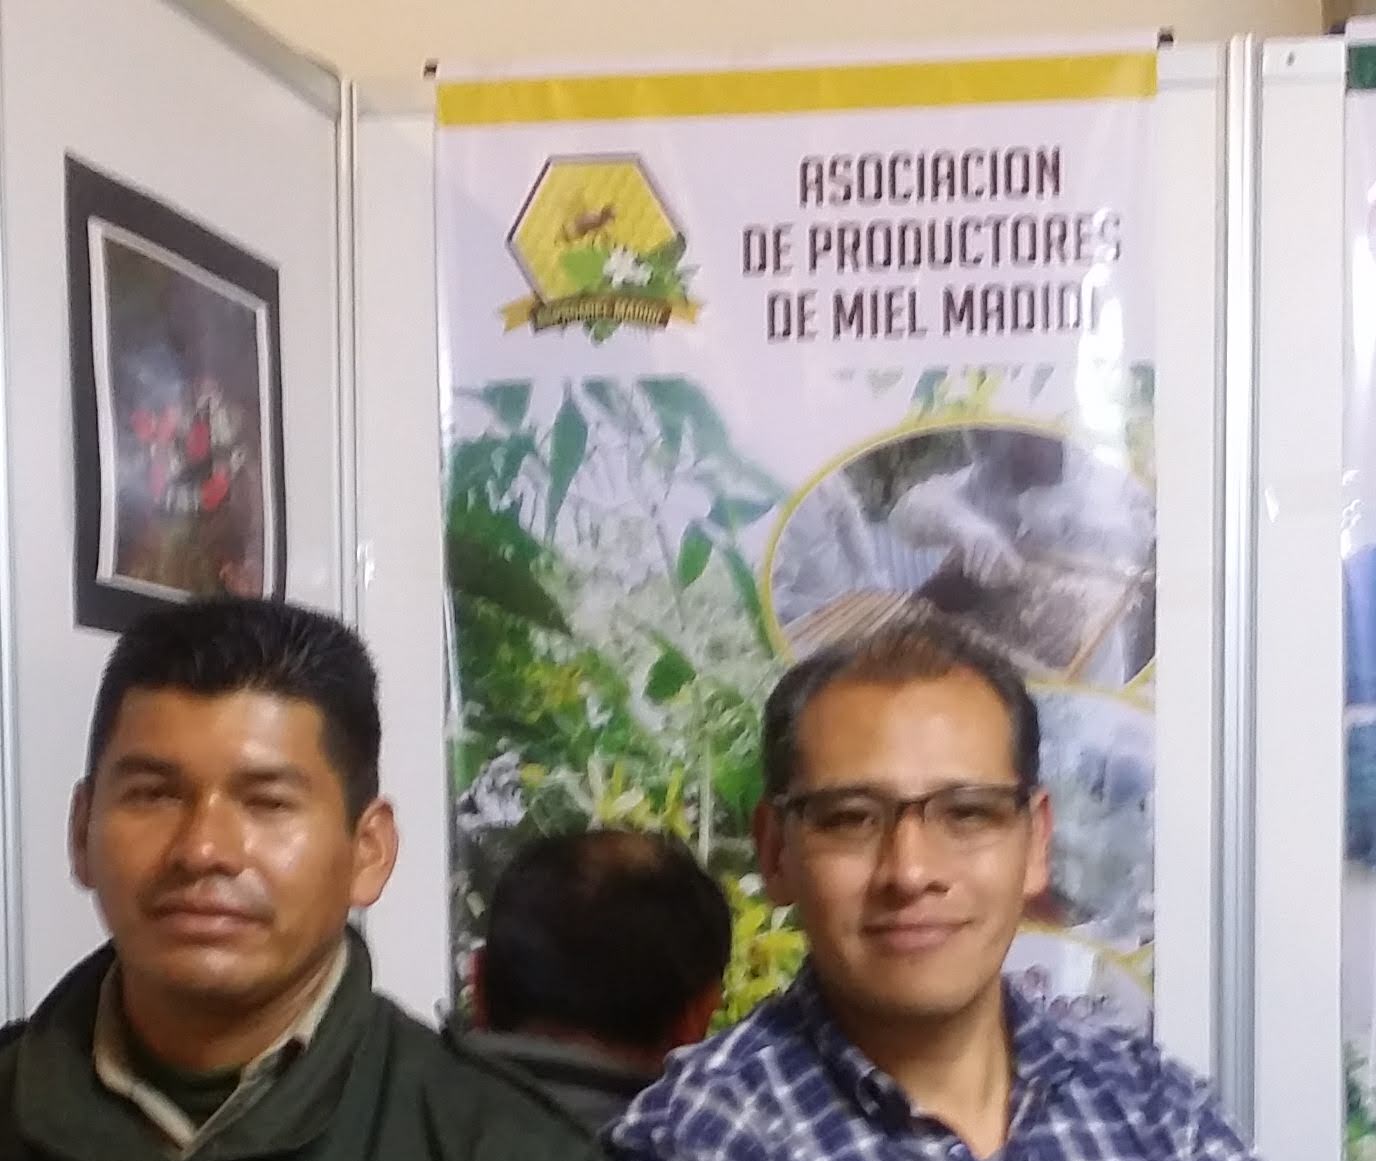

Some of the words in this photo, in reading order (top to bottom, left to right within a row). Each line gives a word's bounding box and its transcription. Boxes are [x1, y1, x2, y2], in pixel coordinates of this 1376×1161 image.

[799, 146, 1062, 207] ASOCIACION
[741, 222, 793, 277] DE
[808, 210, 1123, 275] PRODUCTORES
[766, 288, 818, 343] DE
[831, 284, 927, 342] MIEL
